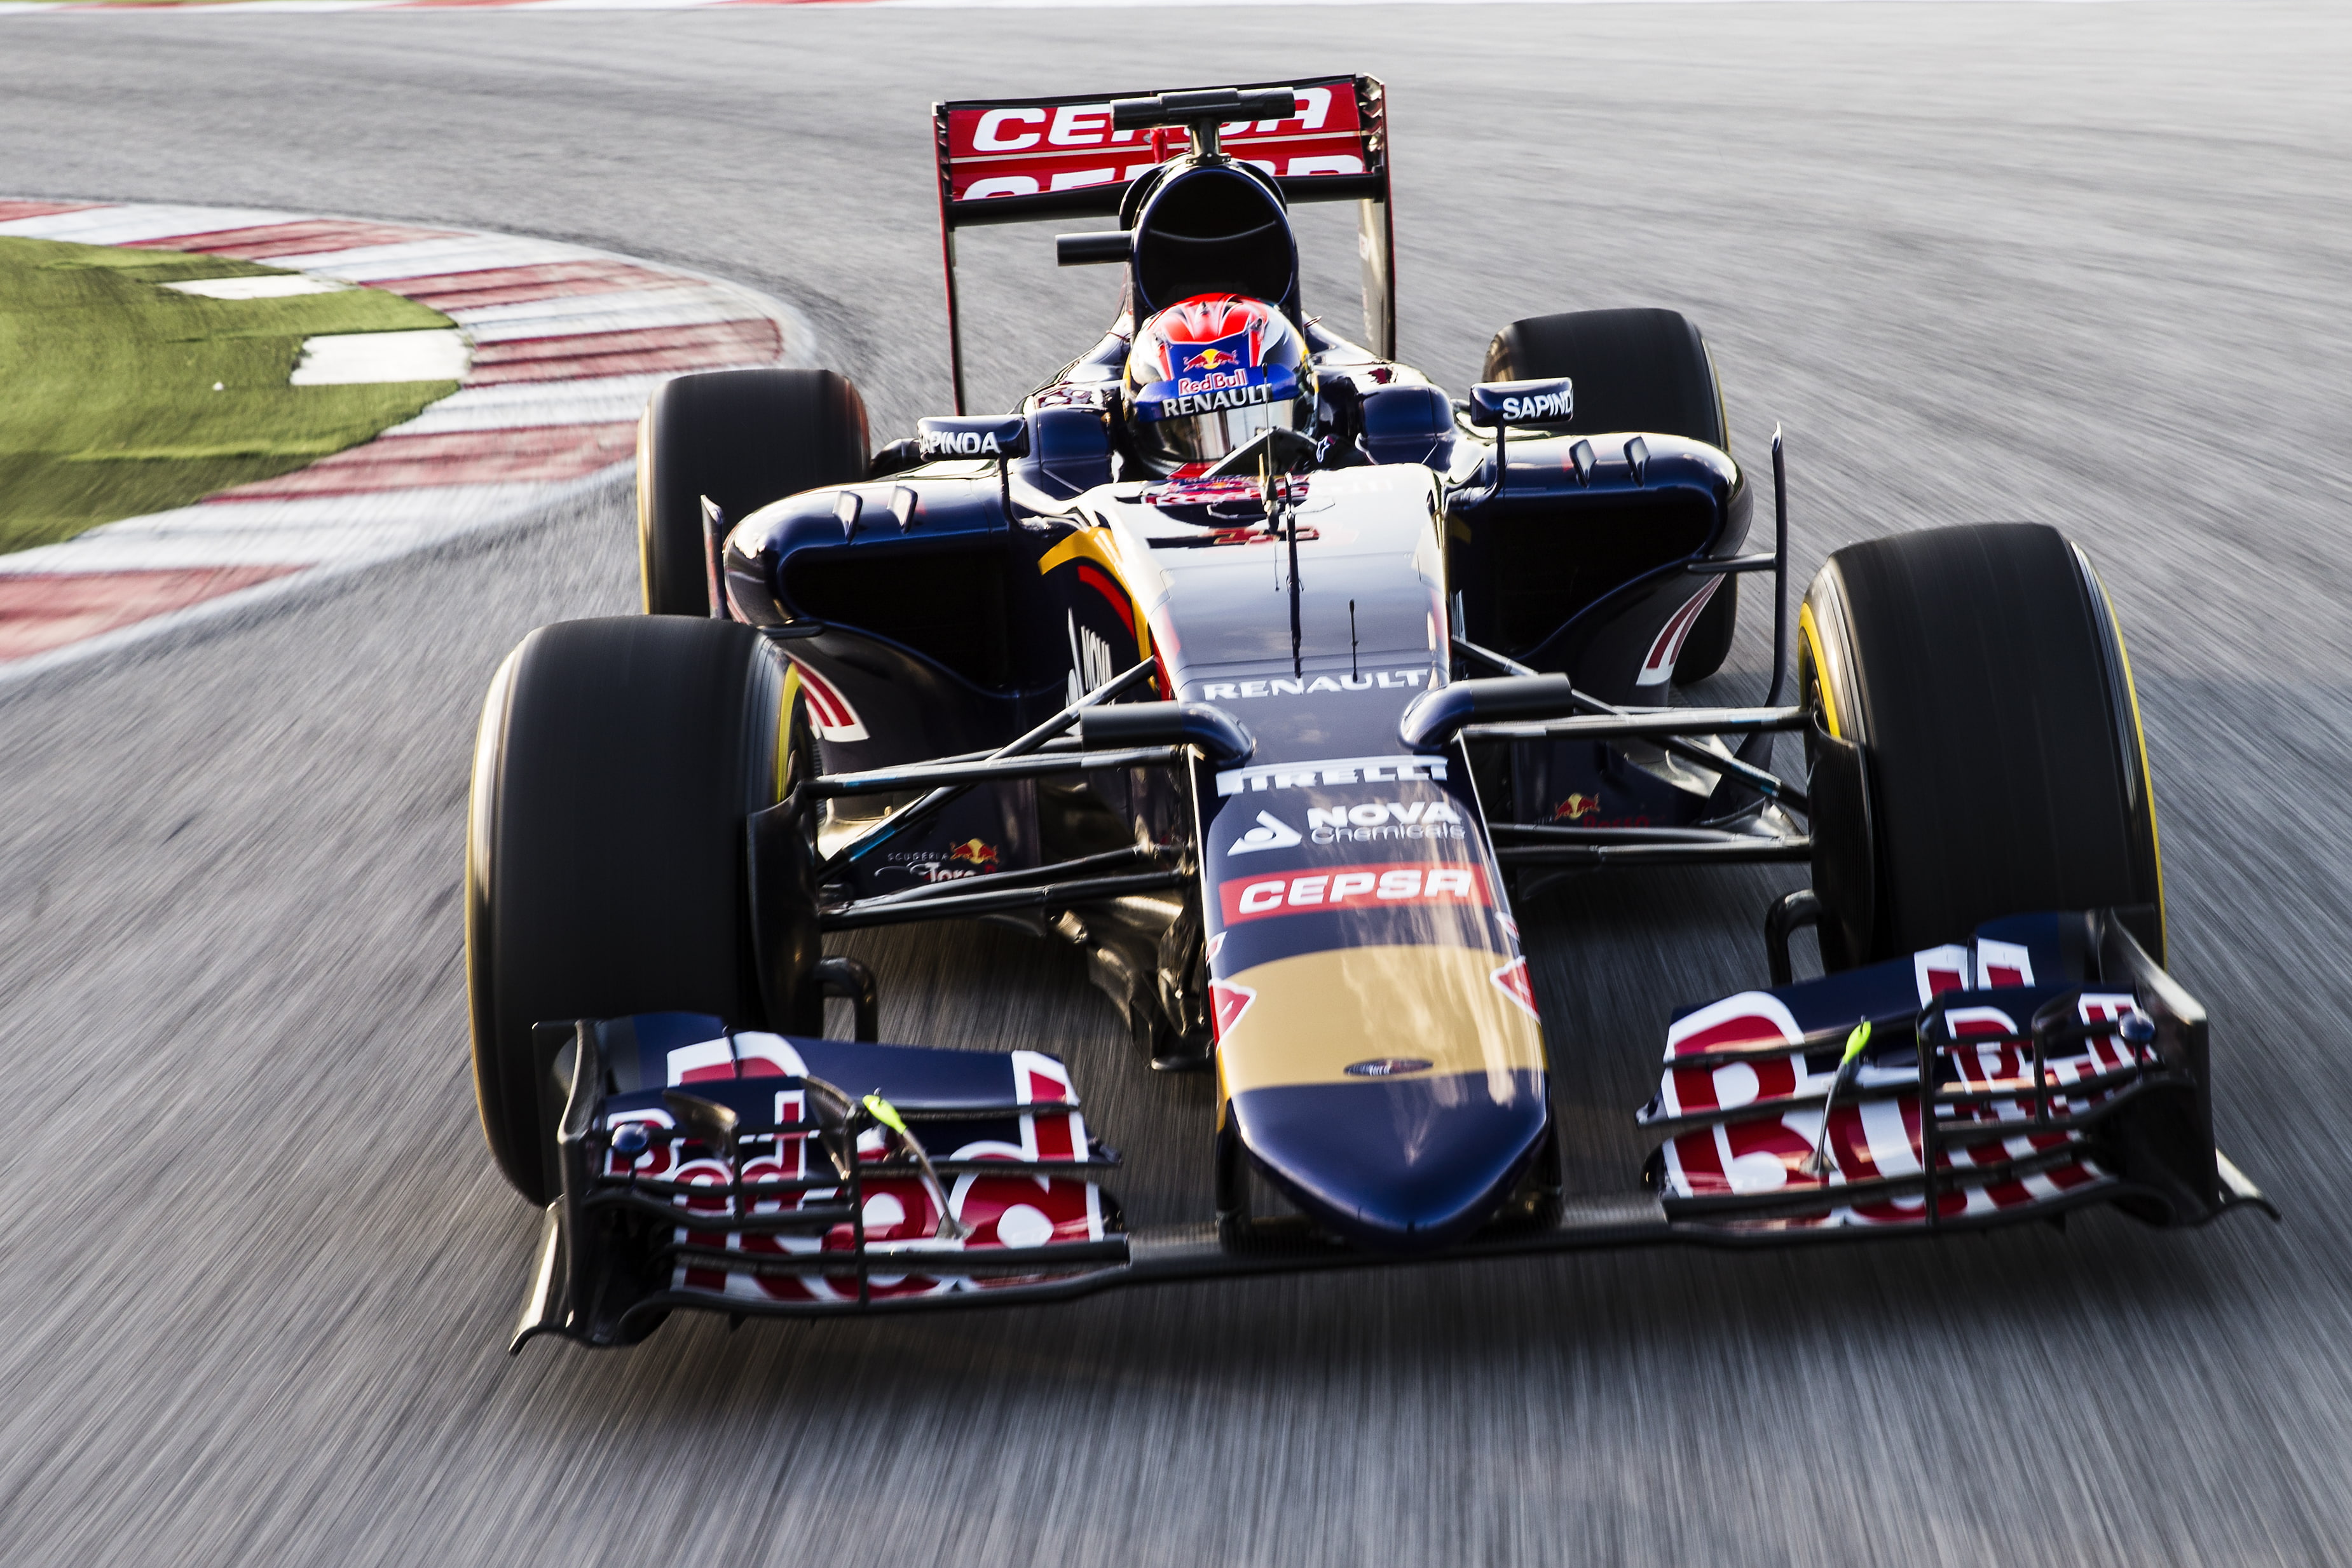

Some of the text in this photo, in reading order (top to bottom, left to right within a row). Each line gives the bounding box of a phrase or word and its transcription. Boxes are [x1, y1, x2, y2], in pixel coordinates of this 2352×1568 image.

[973, 88, 1332, 152] CEA
[1178, 367, 1249, 396] Red Bull
[1162, 383, 1273, 417] RENAULT
[1502, 390, 1574, 421] SAPIND
[1203, 669, 1428, 700] RENAULT
[1307, 801, 1462, 829] NOVA
[1311, 821, 1466, 845] Chemicals
[1239, 869, 1473, 915] CEPSA
